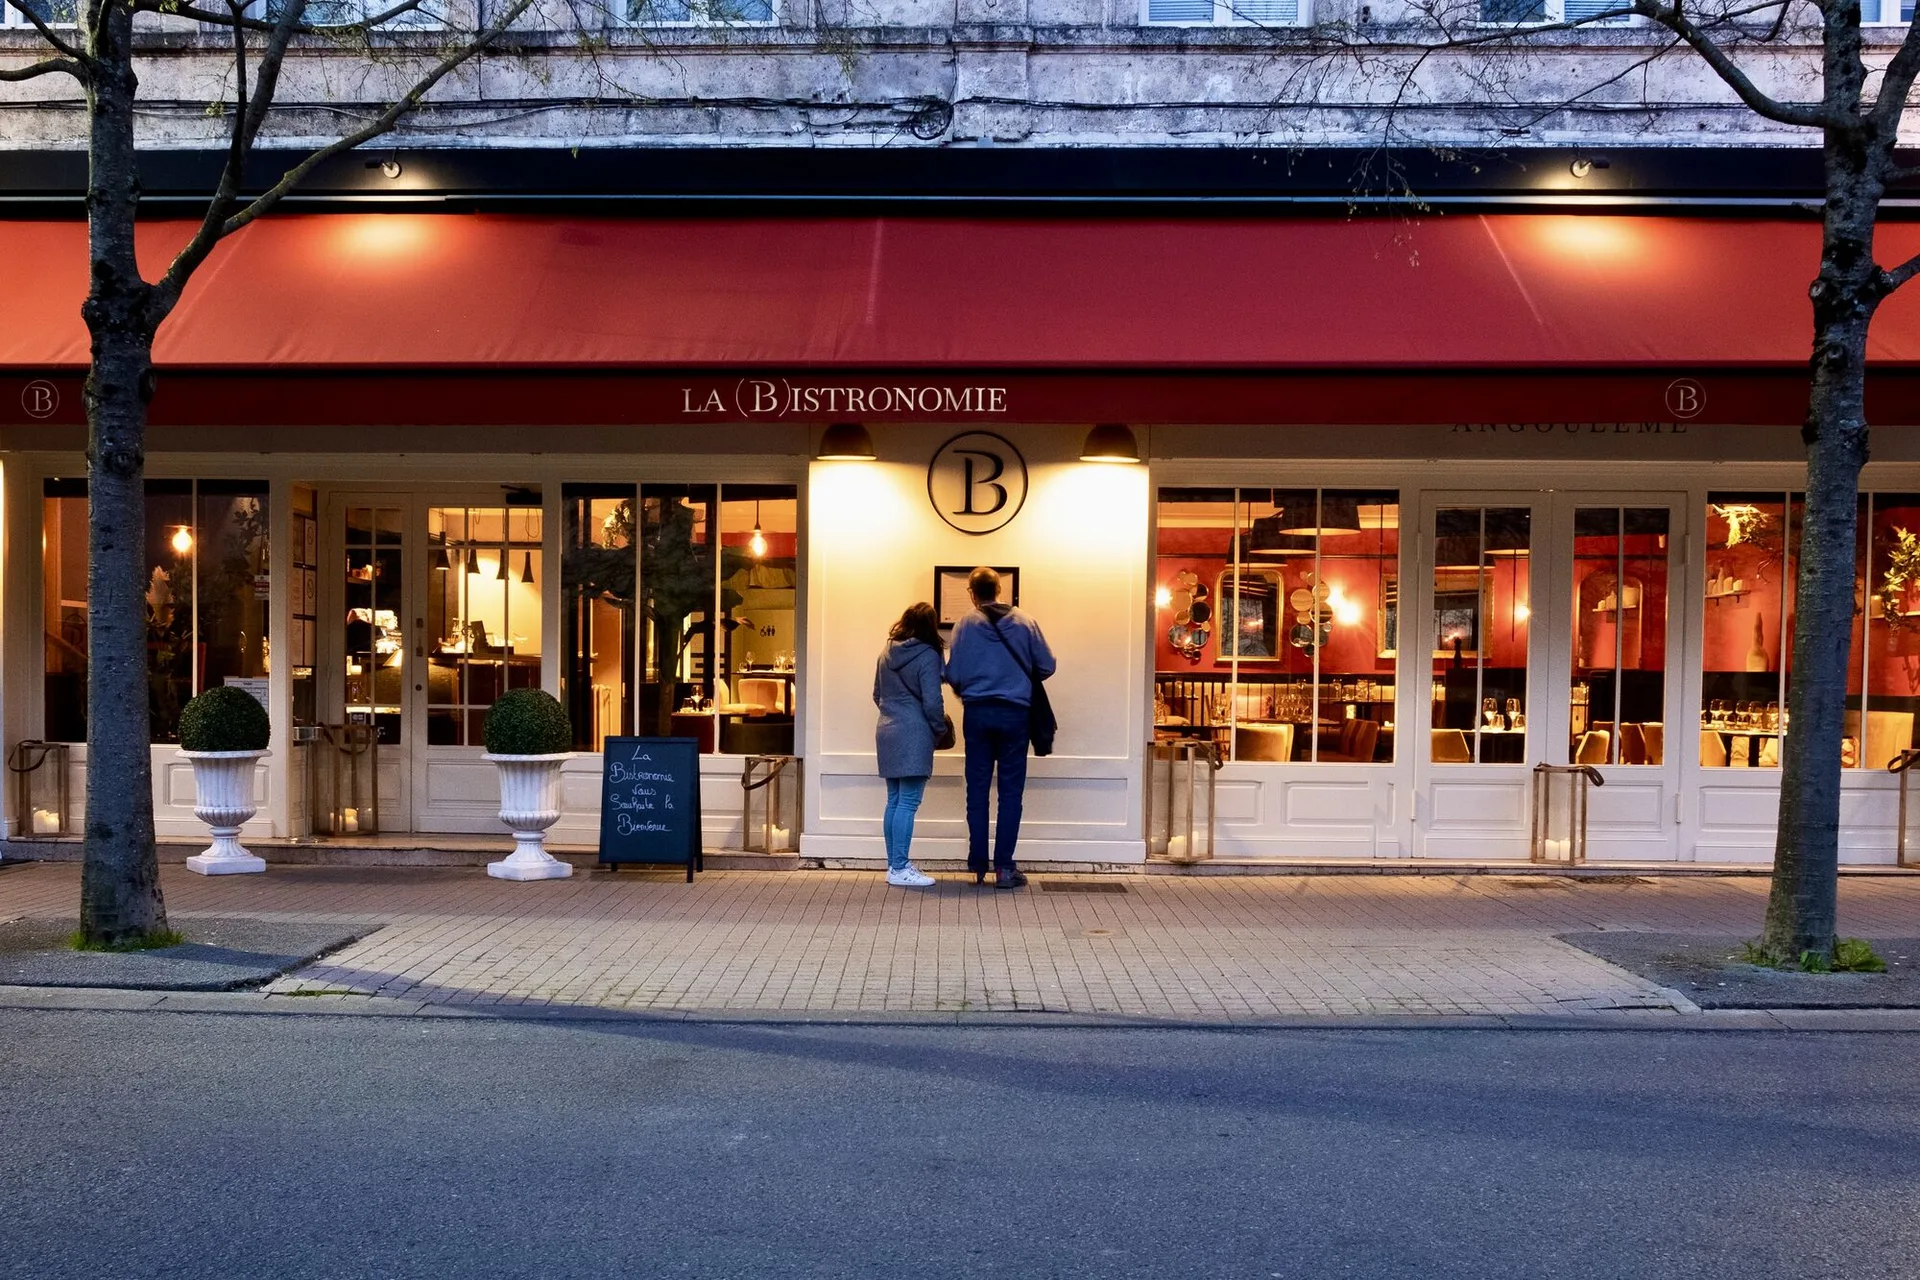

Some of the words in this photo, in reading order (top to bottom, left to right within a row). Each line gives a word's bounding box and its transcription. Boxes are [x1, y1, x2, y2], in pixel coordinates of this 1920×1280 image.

[33, 387, 52, 411] B
[681, 387, 727, 413] LA
[735, 378, 1008, 417] (B)ISTRONOMIE
[1674, 385, 1698, 412] B
[952, 450, 1007, 515] B
[631, 745, 652, 761] La
